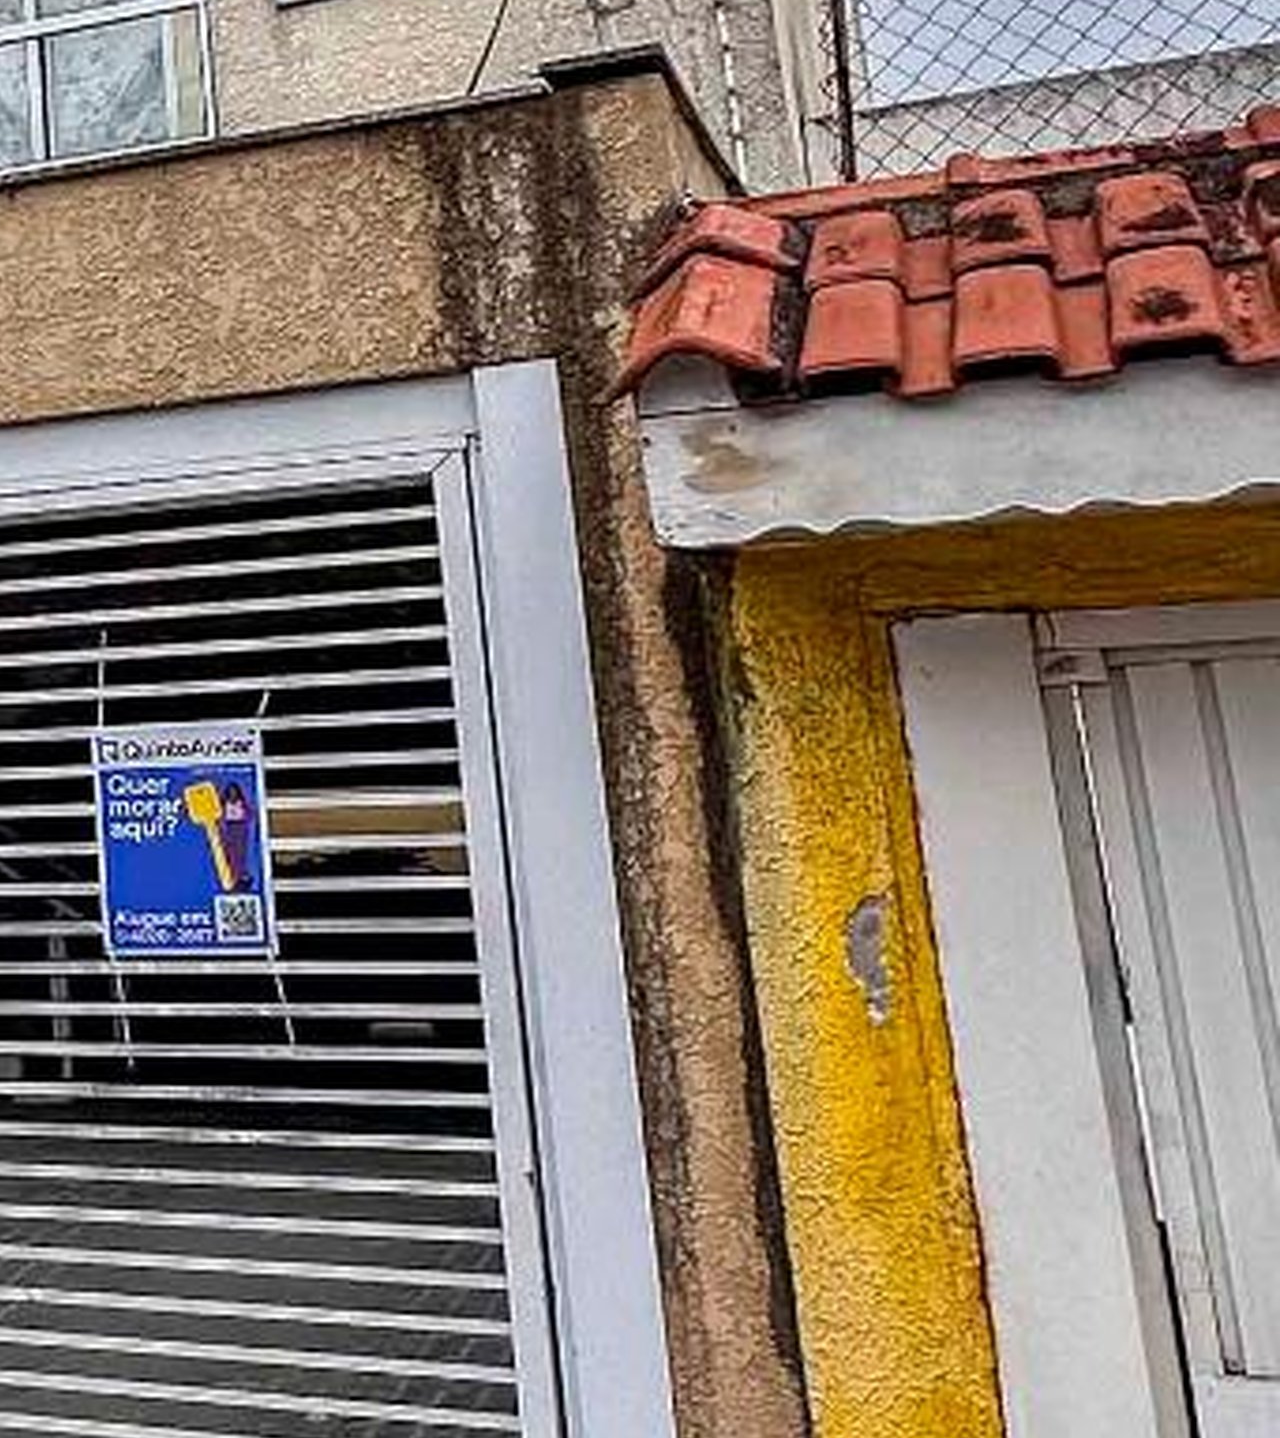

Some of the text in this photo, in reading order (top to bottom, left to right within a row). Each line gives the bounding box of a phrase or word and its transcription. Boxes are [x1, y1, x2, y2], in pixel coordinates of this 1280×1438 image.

[123, 736, 254, 759] QuintoAndar
[107, 774, 171, 796] Quer
[109, 798, 183, 818] morar
[109, 815, 179, 843] aqui?
